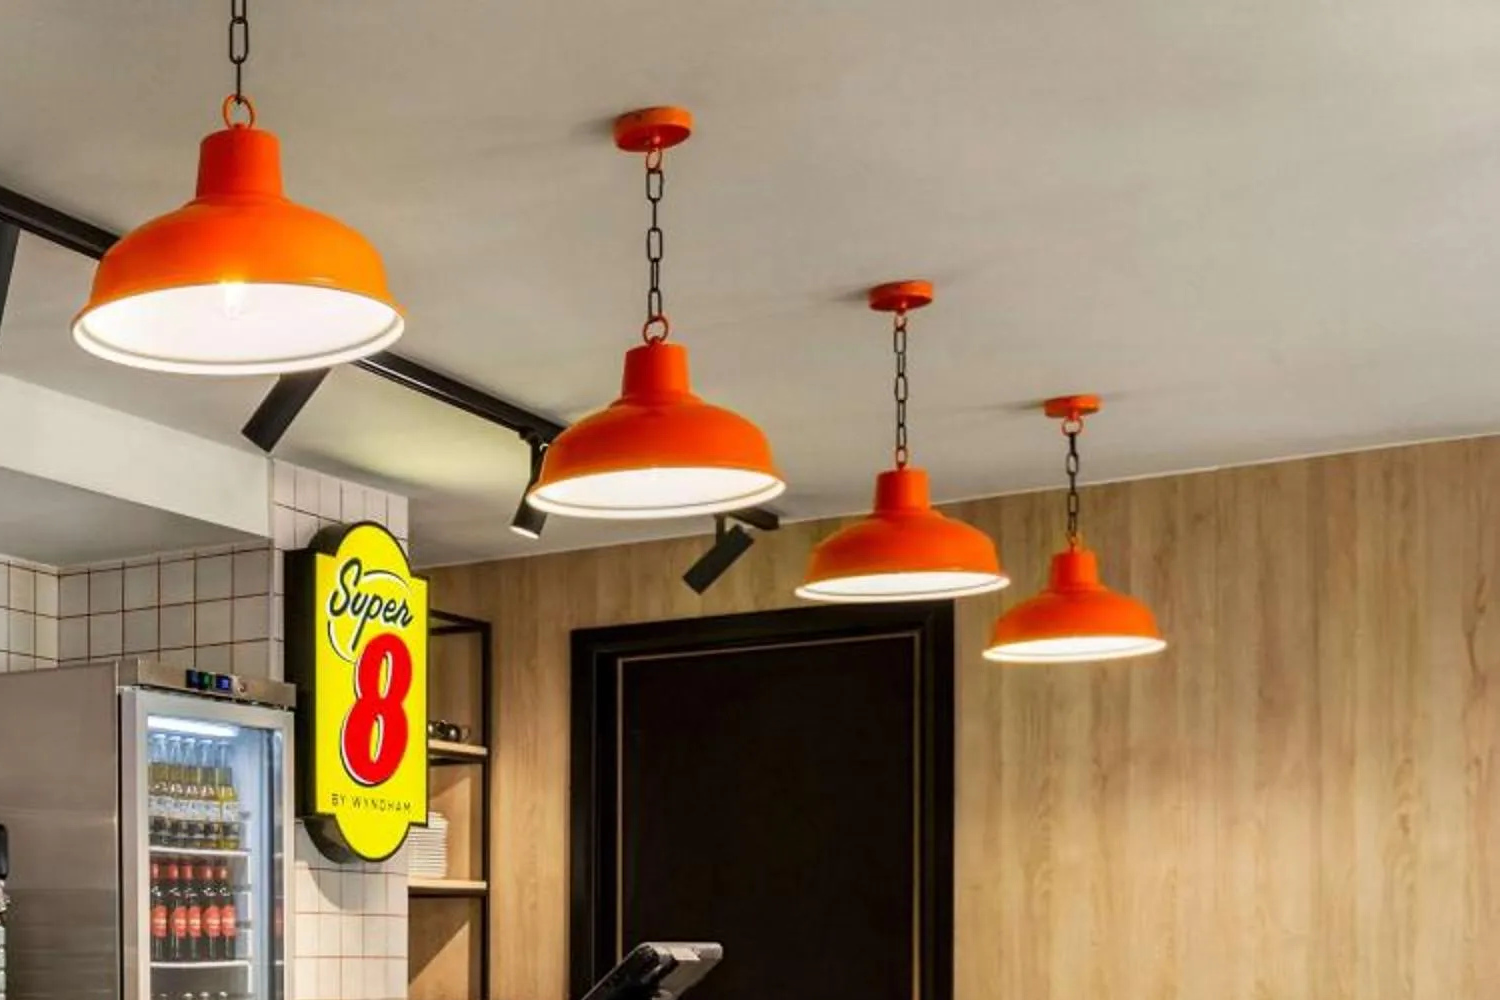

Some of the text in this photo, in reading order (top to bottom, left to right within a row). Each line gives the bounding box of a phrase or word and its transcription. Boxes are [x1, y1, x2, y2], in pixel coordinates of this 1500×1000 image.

[327, 556, 414, 652] Super
[340, 632, 413, 788] 8
[331, 792, 411, 812] BY WYNDHAM
